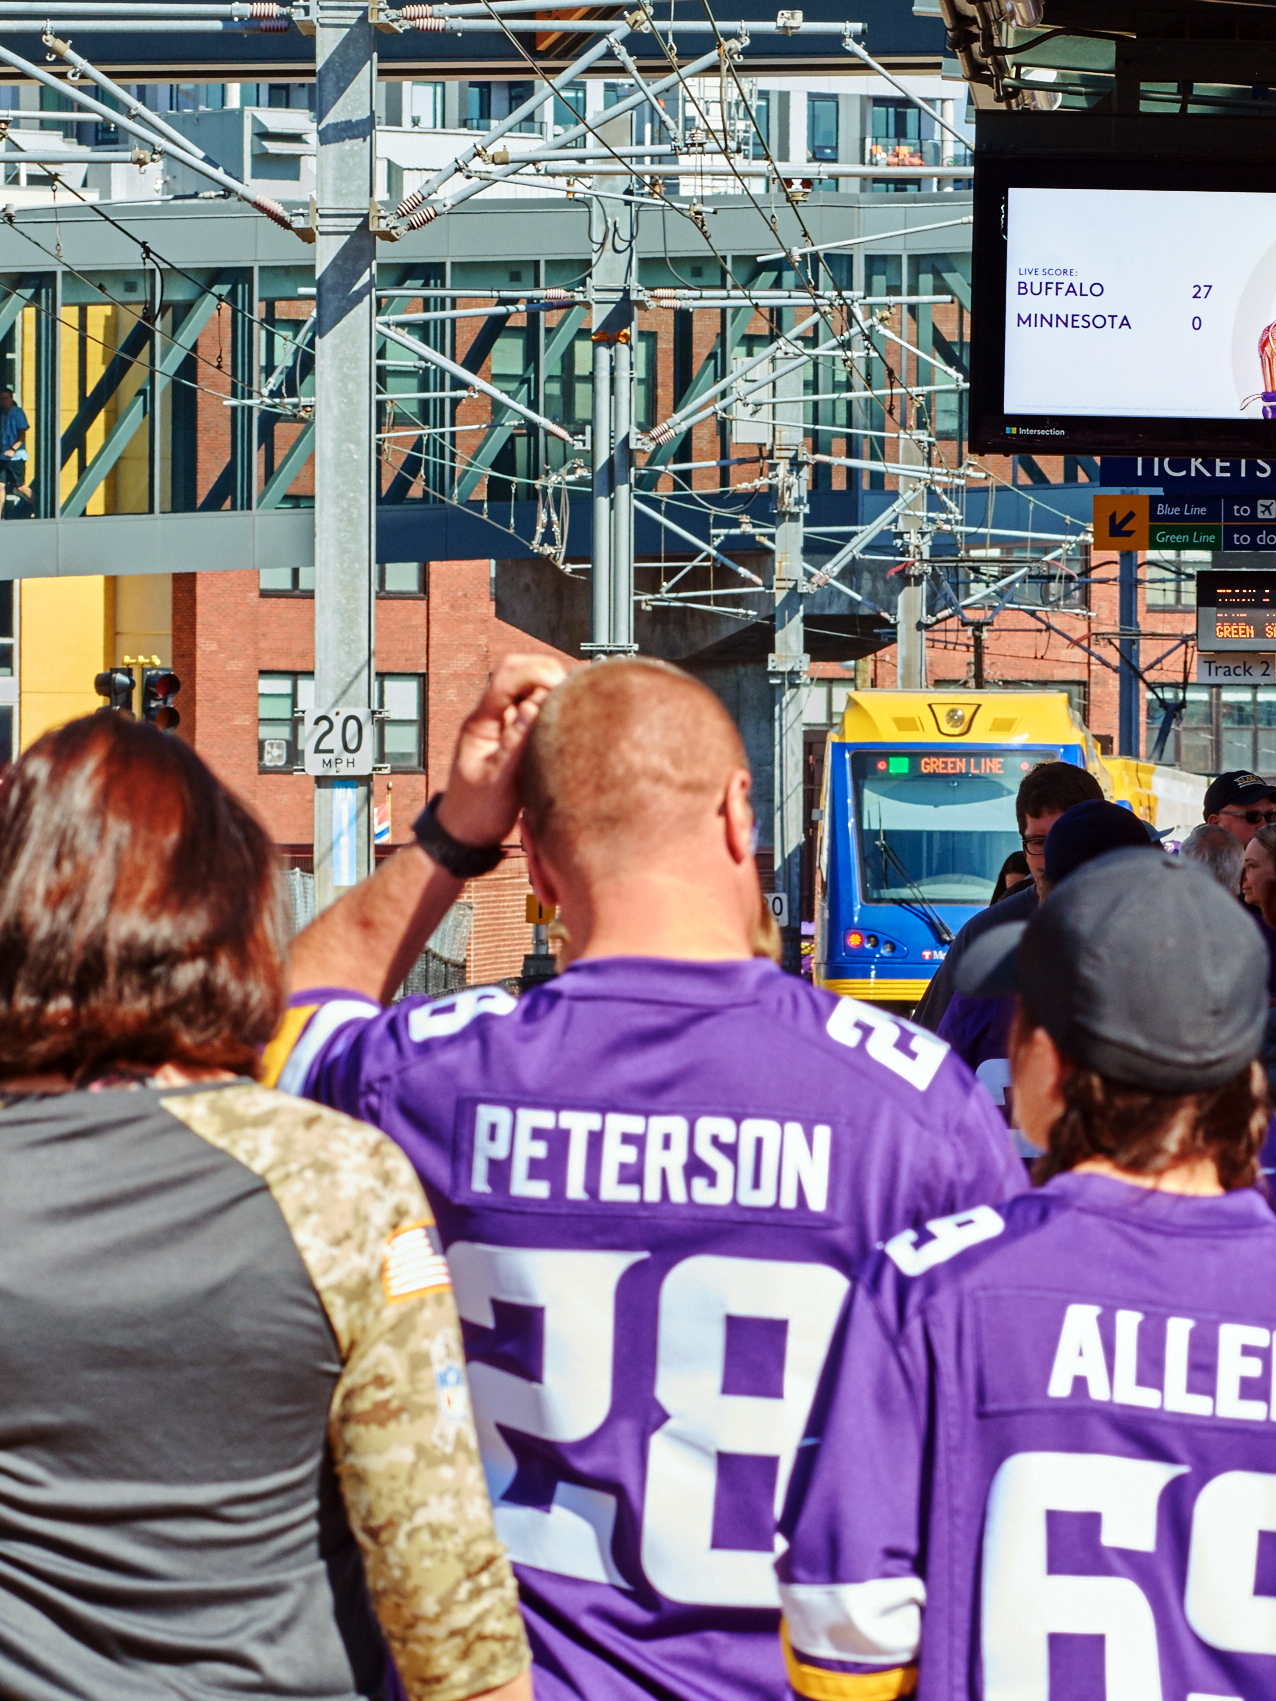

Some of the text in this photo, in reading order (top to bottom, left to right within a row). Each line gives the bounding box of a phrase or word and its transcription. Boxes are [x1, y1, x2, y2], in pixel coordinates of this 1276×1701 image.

[1018, 268, 1078, 277] LIVE SCORE:
[1017, 281, 1213, 299] BUFFALO 27
[1017, 312, 1202, 331] MINNESOTA 0
[1019, 427, 1065, 436] Intersection
[1156, 503, 1181, 516] Blue
[1184, 503, 1207, 516] Line
[1233, 505, 1251, 516] to
[1155, 531, 1189, 543] Green
[1192, 531, 1216, 543] Line
[1233, 534, 1251, 545] to
[1216, 625, 1255, 639] GREEN
[1203, 660, 1271, 677] Track 2
[313, 714, 363, 754] 20
[322, 757, 355, 769] MPH
[920, 757, 1004, 774] GREEN LINE
[827, 997, 949, 1091] 2
[471, 1105, 832, 1212] PETERSON
[445, 1240, 852, 1608] 28
